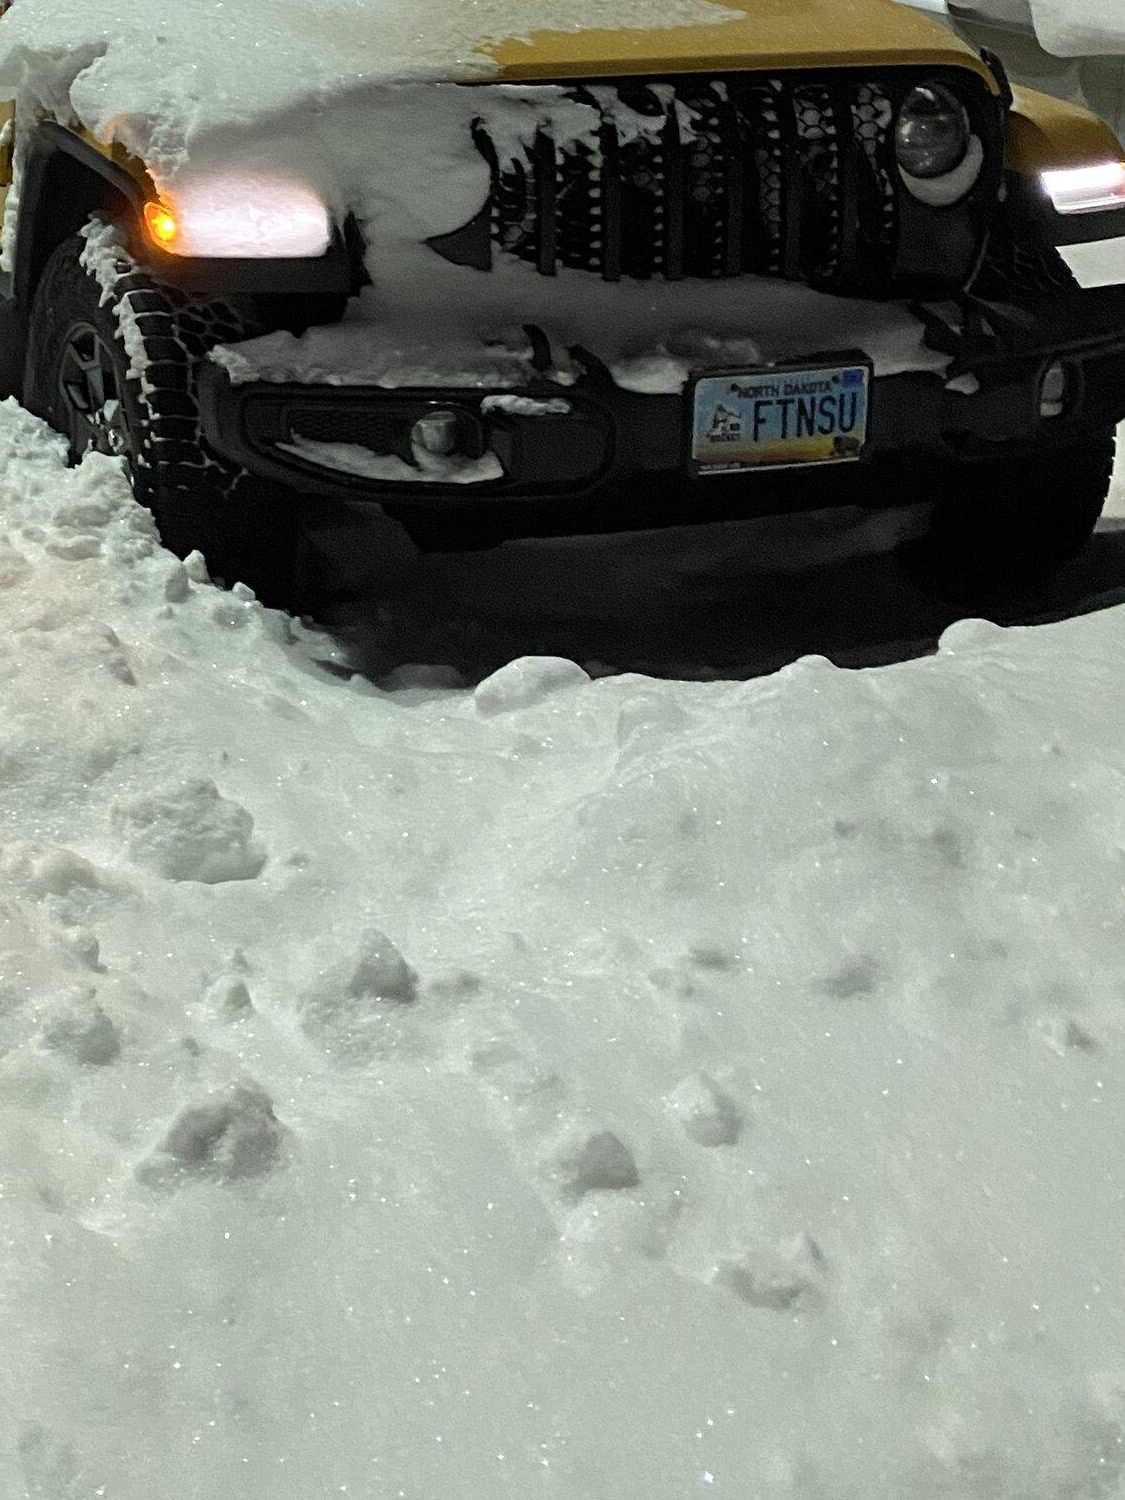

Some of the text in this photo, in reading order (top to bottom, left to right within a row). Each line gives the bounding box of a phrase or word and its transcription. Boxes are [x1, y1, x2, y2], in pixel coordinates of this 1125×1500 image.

[738, 381, 832, 398] NORTH DAKOTA
[753, 392, 857, 442] FTNSU
